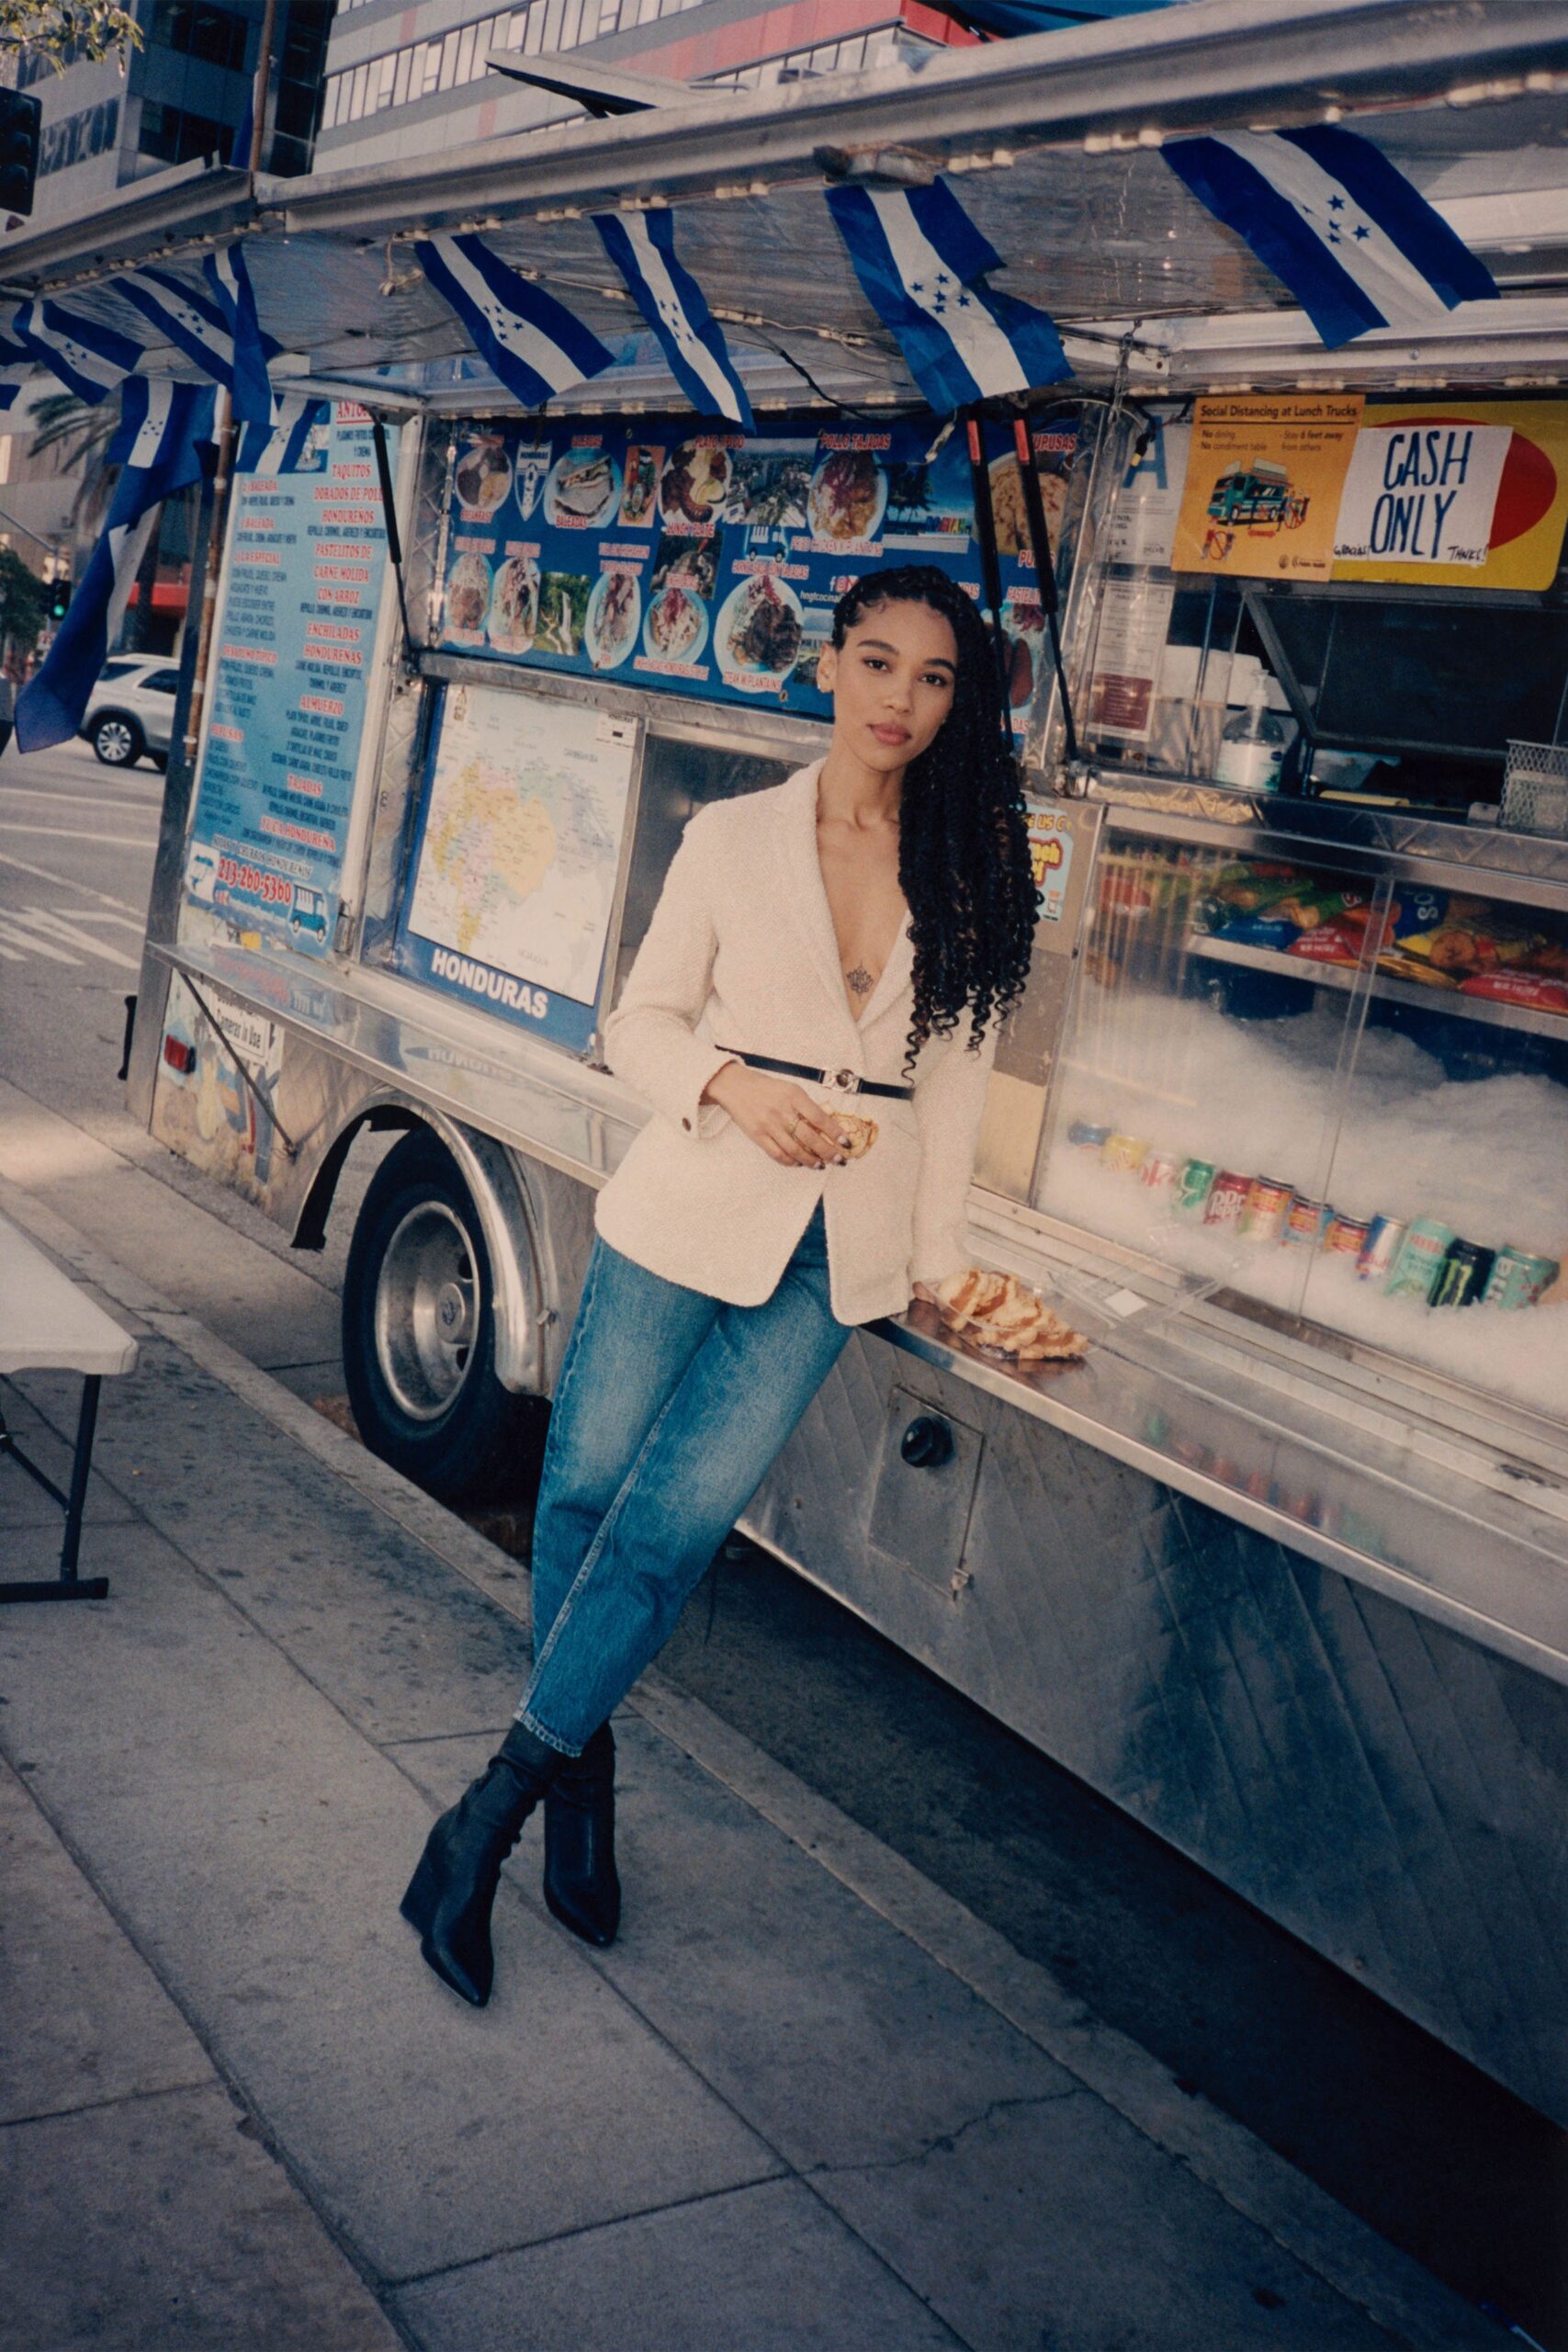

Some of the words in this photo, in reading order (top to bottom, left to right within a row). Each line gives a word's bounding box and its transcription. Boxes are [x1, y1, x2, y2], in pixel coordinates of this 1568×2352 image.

[1201, 405, 1228, 417] Social
[1230, 405, 1280, 419] Distancing
[1281, 406, 1292, 417] at
[1294, 405, 1323, 417] Lunch
[1326, 405, 1358, 417] Trucks
[820, 434, 850, 449] POLLO
[1032, 434, 1077, 451] UPUSAS
[1201, 429, 1213, 438] No
[1214, 430, 1236, 441] dining
[1300, 430, 1306, 439] 6
[1307, 430, 1323, 439] feet
[1325, 432, 1344, 442] away
[1122, 415, 1168, 490] A
[1201, 442, 1212, 450] No
[1213, 442, 1249, 451] condiment
[1250, 442, 1268, 451] table
[1281, 443, 1298, 452] from
[1300, 443, 1323, 452] others
[1383, 430, 1473, 491] CASH
[332, 463, 372, 481] TAQUITOS
[351, 487, 361, 501] DE
[363, 488, 383, 502] POLL
[321, 506, 375, 524] HONDUREÑOS
[1371, 490, 1458, 560] ONLY
[315, 543, 360, 559] PASTELITOS
[361, 545, 373, 560] DE
[314, 565, 339, 580] CARNE
[340, 567, 369, 582] MOLIDA
[317, 587, 333, 602] CON
[334, 589, 360, 605] ARROZ
[308, 623, 360, 642] ENCHILADAS
[304, 643, 362, 665] HONDUREÑAS
[301, 695, 344, 716] ALMUERZO
[284, 823, 335, 853] HONDUREÑA
[218, 856, 292, 904] 213-260-5360
[431, 948, 549, 1020] HONDURAS
